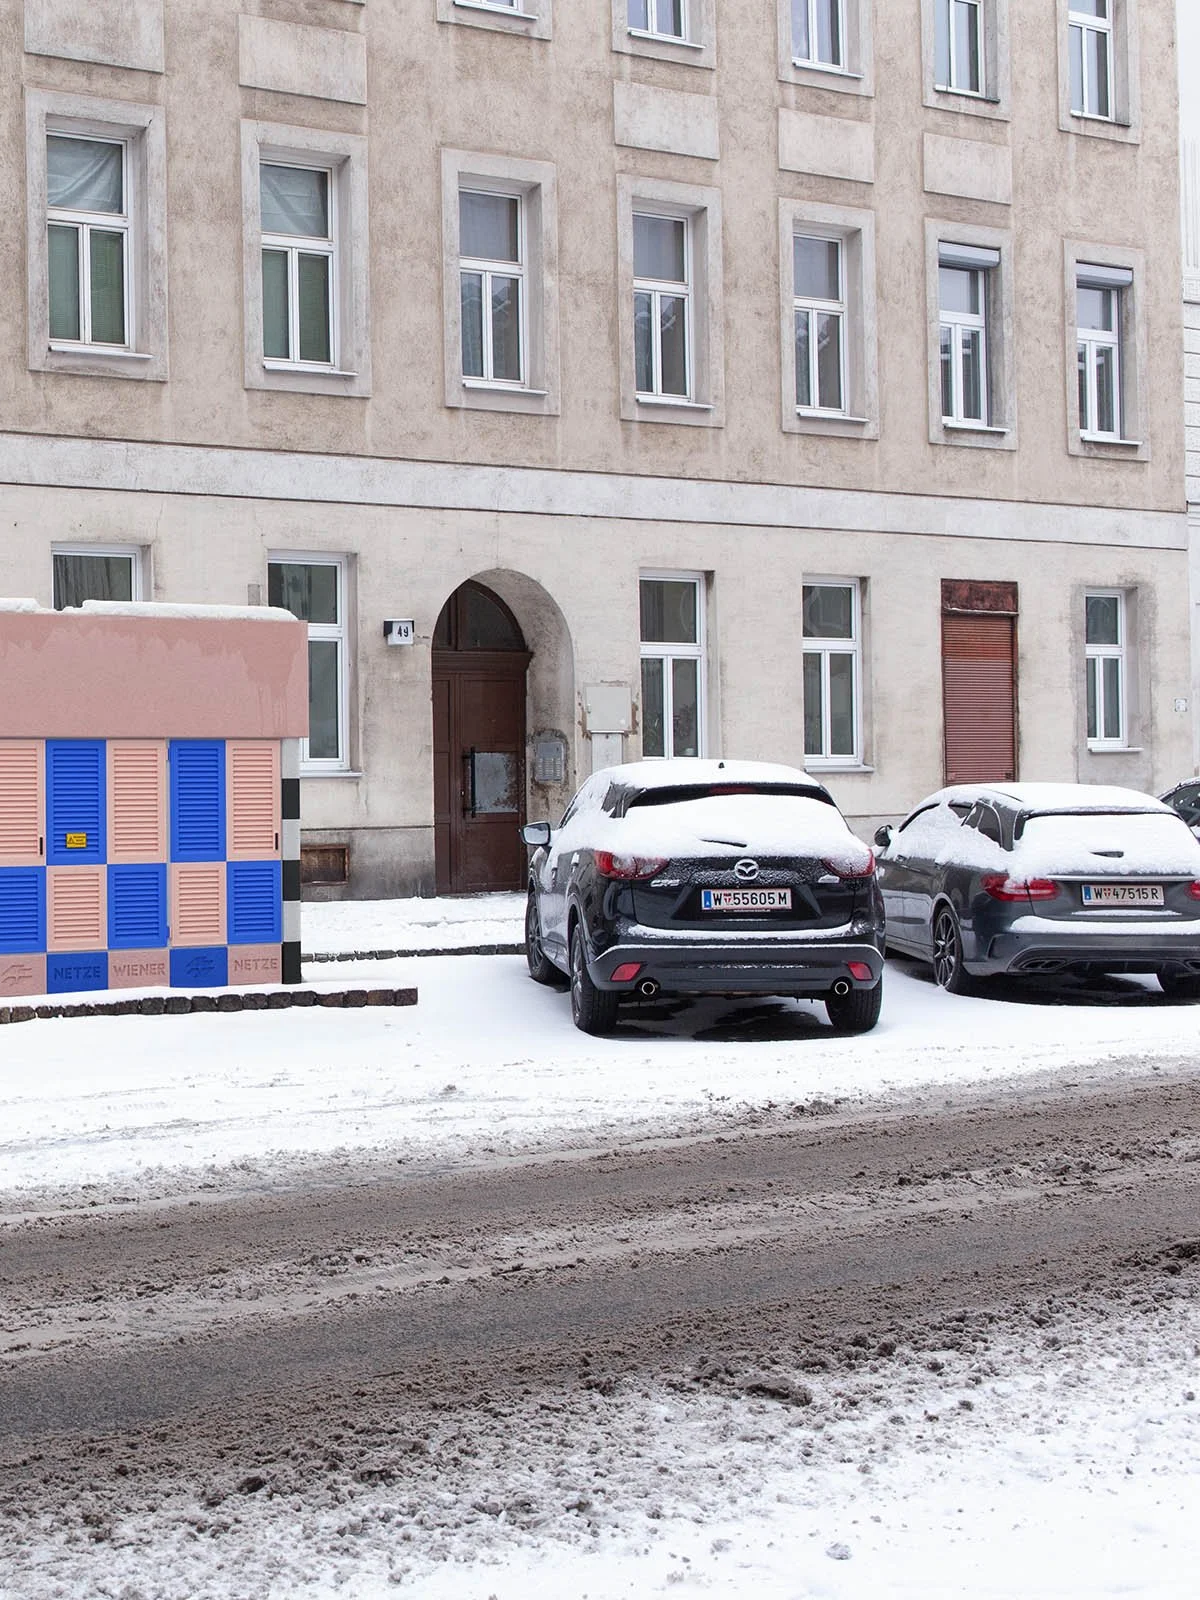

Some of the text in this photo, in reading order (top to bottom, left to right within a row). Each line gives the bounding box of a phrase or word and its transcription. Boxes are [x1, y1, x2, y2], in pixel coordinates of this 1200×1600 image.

[397, 625, 409, 638] 49
[712, 892, 723, 906] W
[732, 892, 776, 906] 55605
[778, 892, 787, 905] M
[1093, 887, 1159, 900] W 47515 R
[53, 966, 101, 980] NETZE
[112, 958, 279, 977] WIENER NETZE
